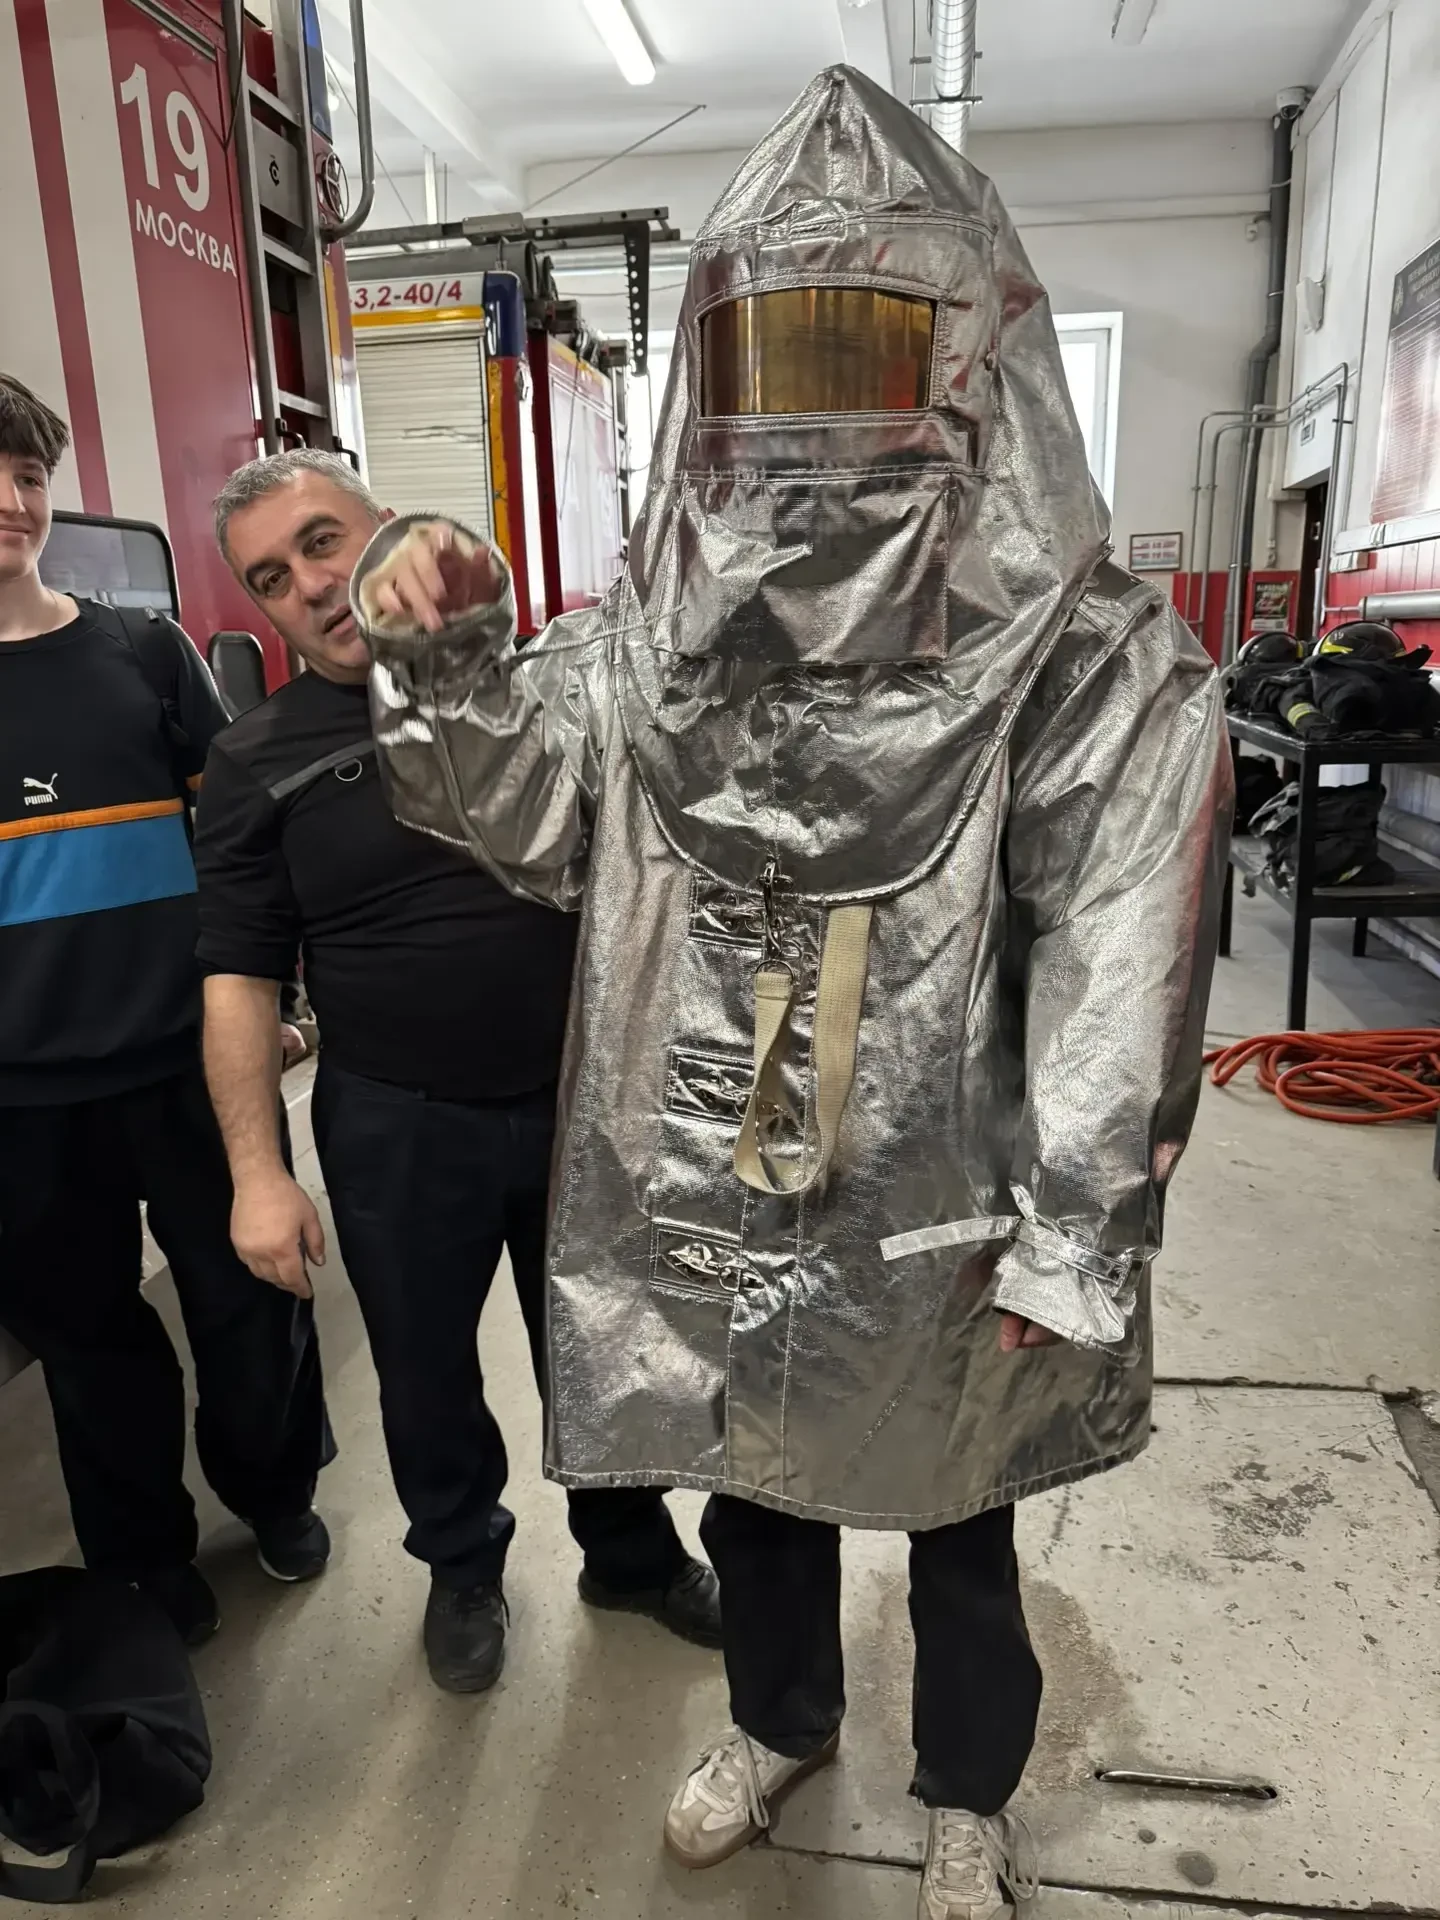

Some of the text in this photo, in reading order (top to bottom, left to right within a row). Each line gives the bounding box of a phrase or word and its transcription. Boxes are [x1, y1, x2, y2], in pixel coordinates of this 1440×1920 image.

[120, 63, 210, 212] 19
[135, 199, 237, 278] МОСКВА
[24, 793, 53, 806] PUMA
